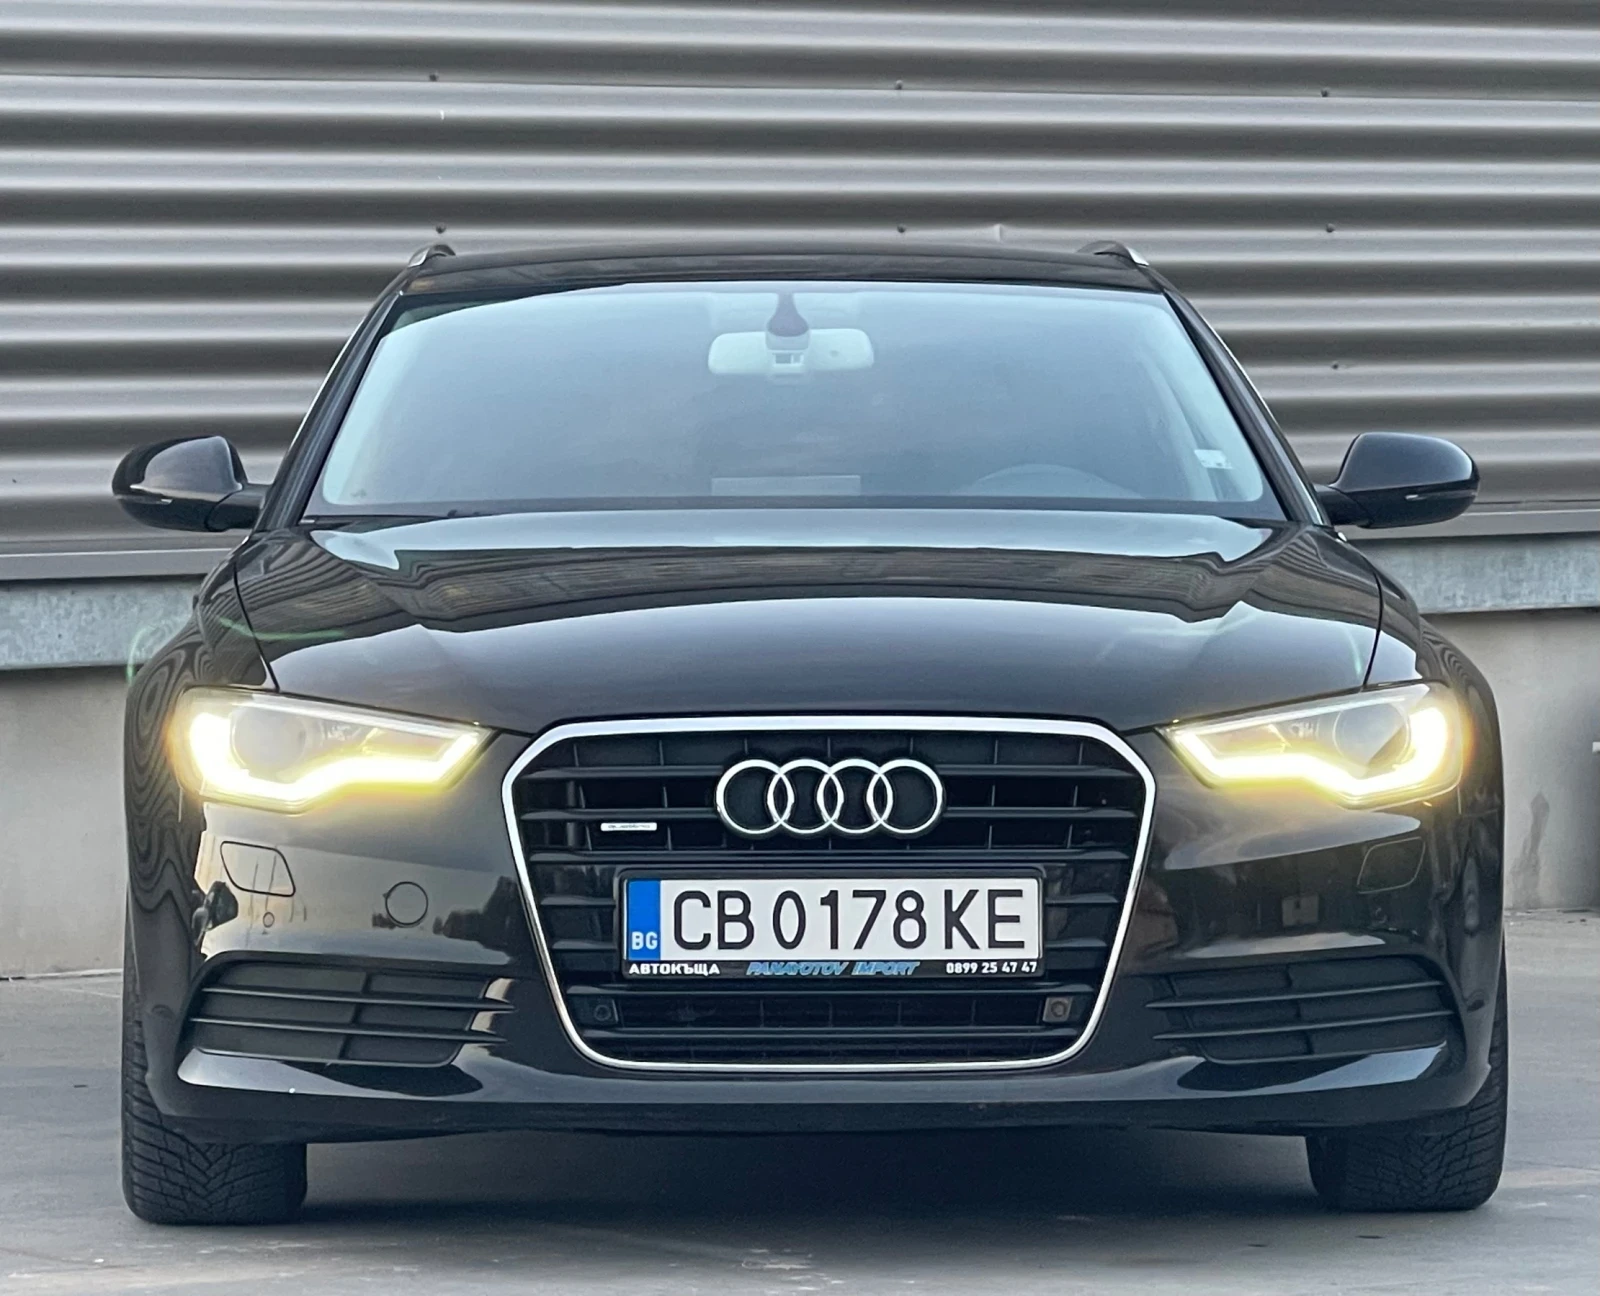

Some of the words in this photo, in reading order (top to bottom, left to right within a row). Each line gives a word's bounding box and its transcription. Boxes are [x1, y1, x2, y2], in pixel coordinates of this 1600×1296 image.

[674, 890, 754, 950] CB
[773, 890, 926, 950] 0178
[944, 890, 1024, 949] KE
[632, 931, 658, 950] BG
[628, 963, 720, 976] АВТОКЪЩА
[851, 961, 920, 976] IMPORT
[946, 962, 978, 975] 0899
[981, 962, 998, 974] 25
[1001, 962, 1019, 974] 47
[1021, 961, 1037, 973] 47
